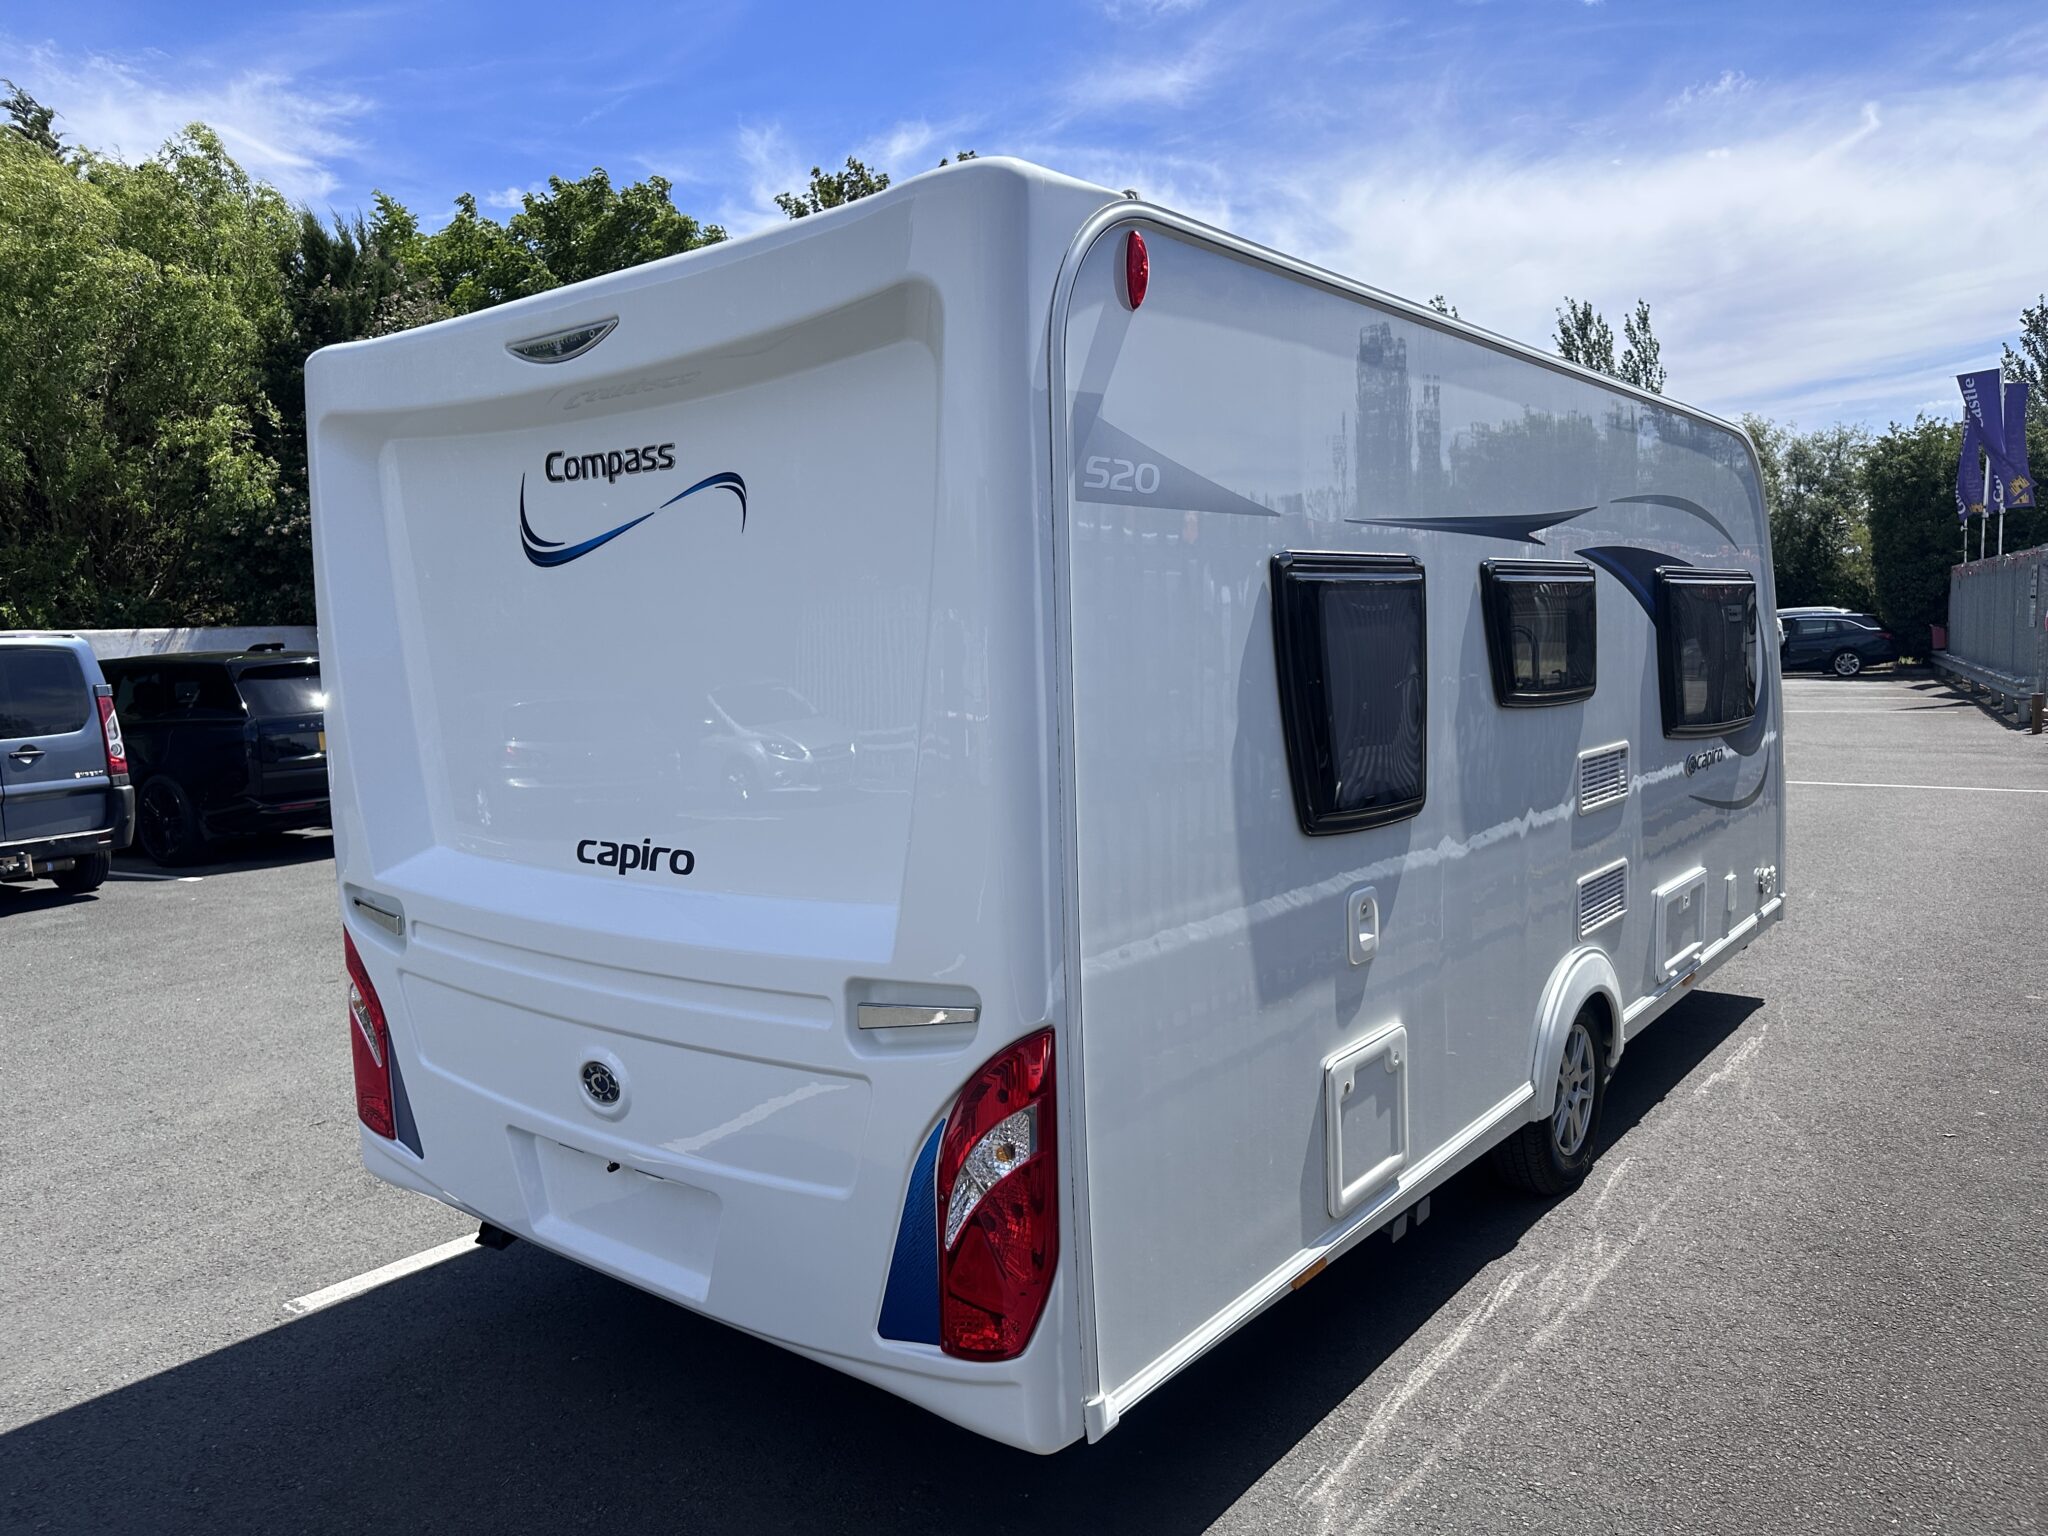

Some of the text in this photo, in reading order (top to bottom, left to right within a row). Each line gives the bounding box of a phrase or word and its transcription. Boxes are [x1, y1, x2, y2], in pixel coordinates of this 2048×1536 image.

[545, 442, 676, 484] Compass
[1083, 455, 1160, 494] 520
[1696, 746, 1723, 771] capiro
[576, 837, 695, 876] capiro
